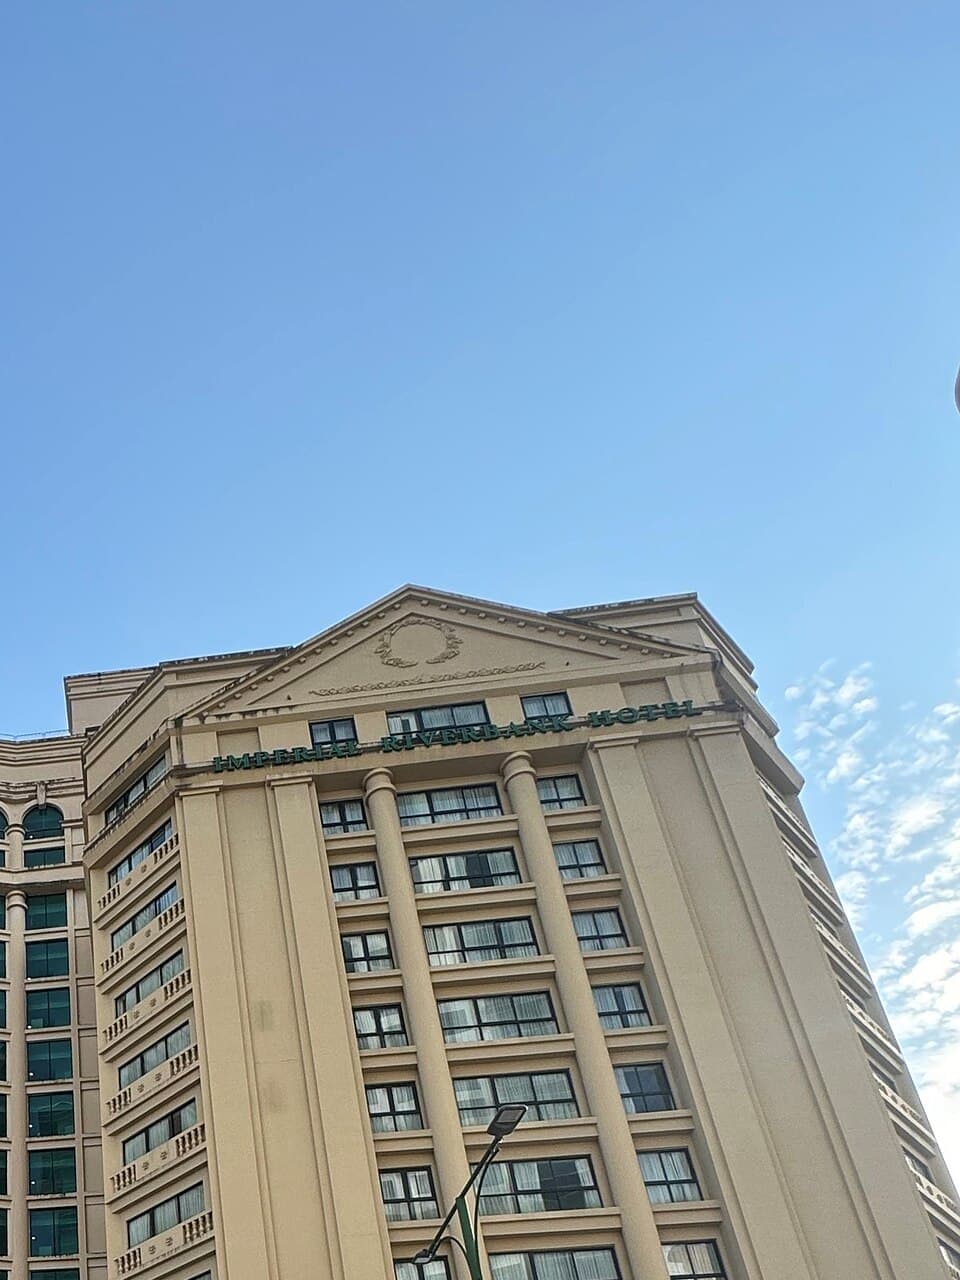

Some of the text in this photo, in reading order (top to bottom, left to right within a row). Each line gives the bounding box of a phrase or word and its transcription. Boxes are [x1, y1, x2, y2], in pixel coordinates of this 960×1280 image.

[212, 700, 703, 773] IMPERIAL RIVERBANK HOTEL
